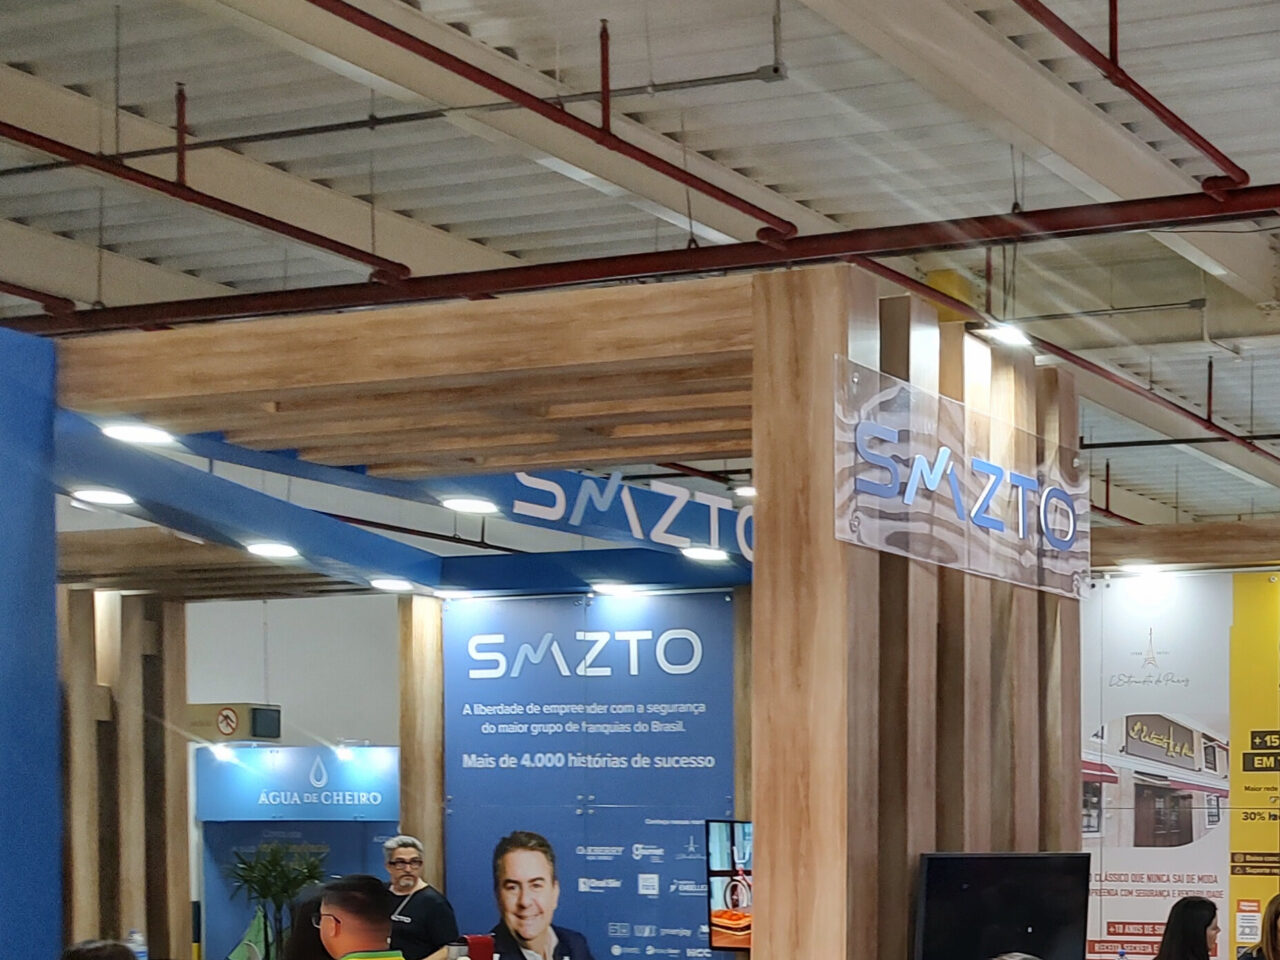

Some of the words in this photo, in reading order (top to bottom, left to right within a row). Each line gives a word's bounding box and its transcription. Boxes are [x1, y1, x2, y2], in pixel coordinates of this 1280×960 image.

[467, 629, 703, 679] SMZTO
[473, 703, 523, 715] liberdade
[526, 703, 541, 714] de
[610, 705, 634, 714] com
[647, 702, 705, 716] segurança
[481, 722, 495, 734] do
[498, 722, 528, 733] maior
[531, 724, 563, 735] grupo
[565, 721, 579, 733] de
[634, 721, 648, 732] do
[462, 754, 496, 768] Mais
[499, 754, 518, 768] de
[520, 754, 565, 768] 4.000
[568, 753, 628, 768] histórias
[631, 753, 651, 768] de
[654, 756, 715, 768] sucesso
[1254, 757, 1275, 768] EM
[258, 789, 301, 804] ÁGUA
[304, 793, 319, 803] DE
[320, 792, 382, 805] CHEIRO
[1242, 811, 1266, 821] 30%
[1089, 888, 1118, 897] PREENDA
